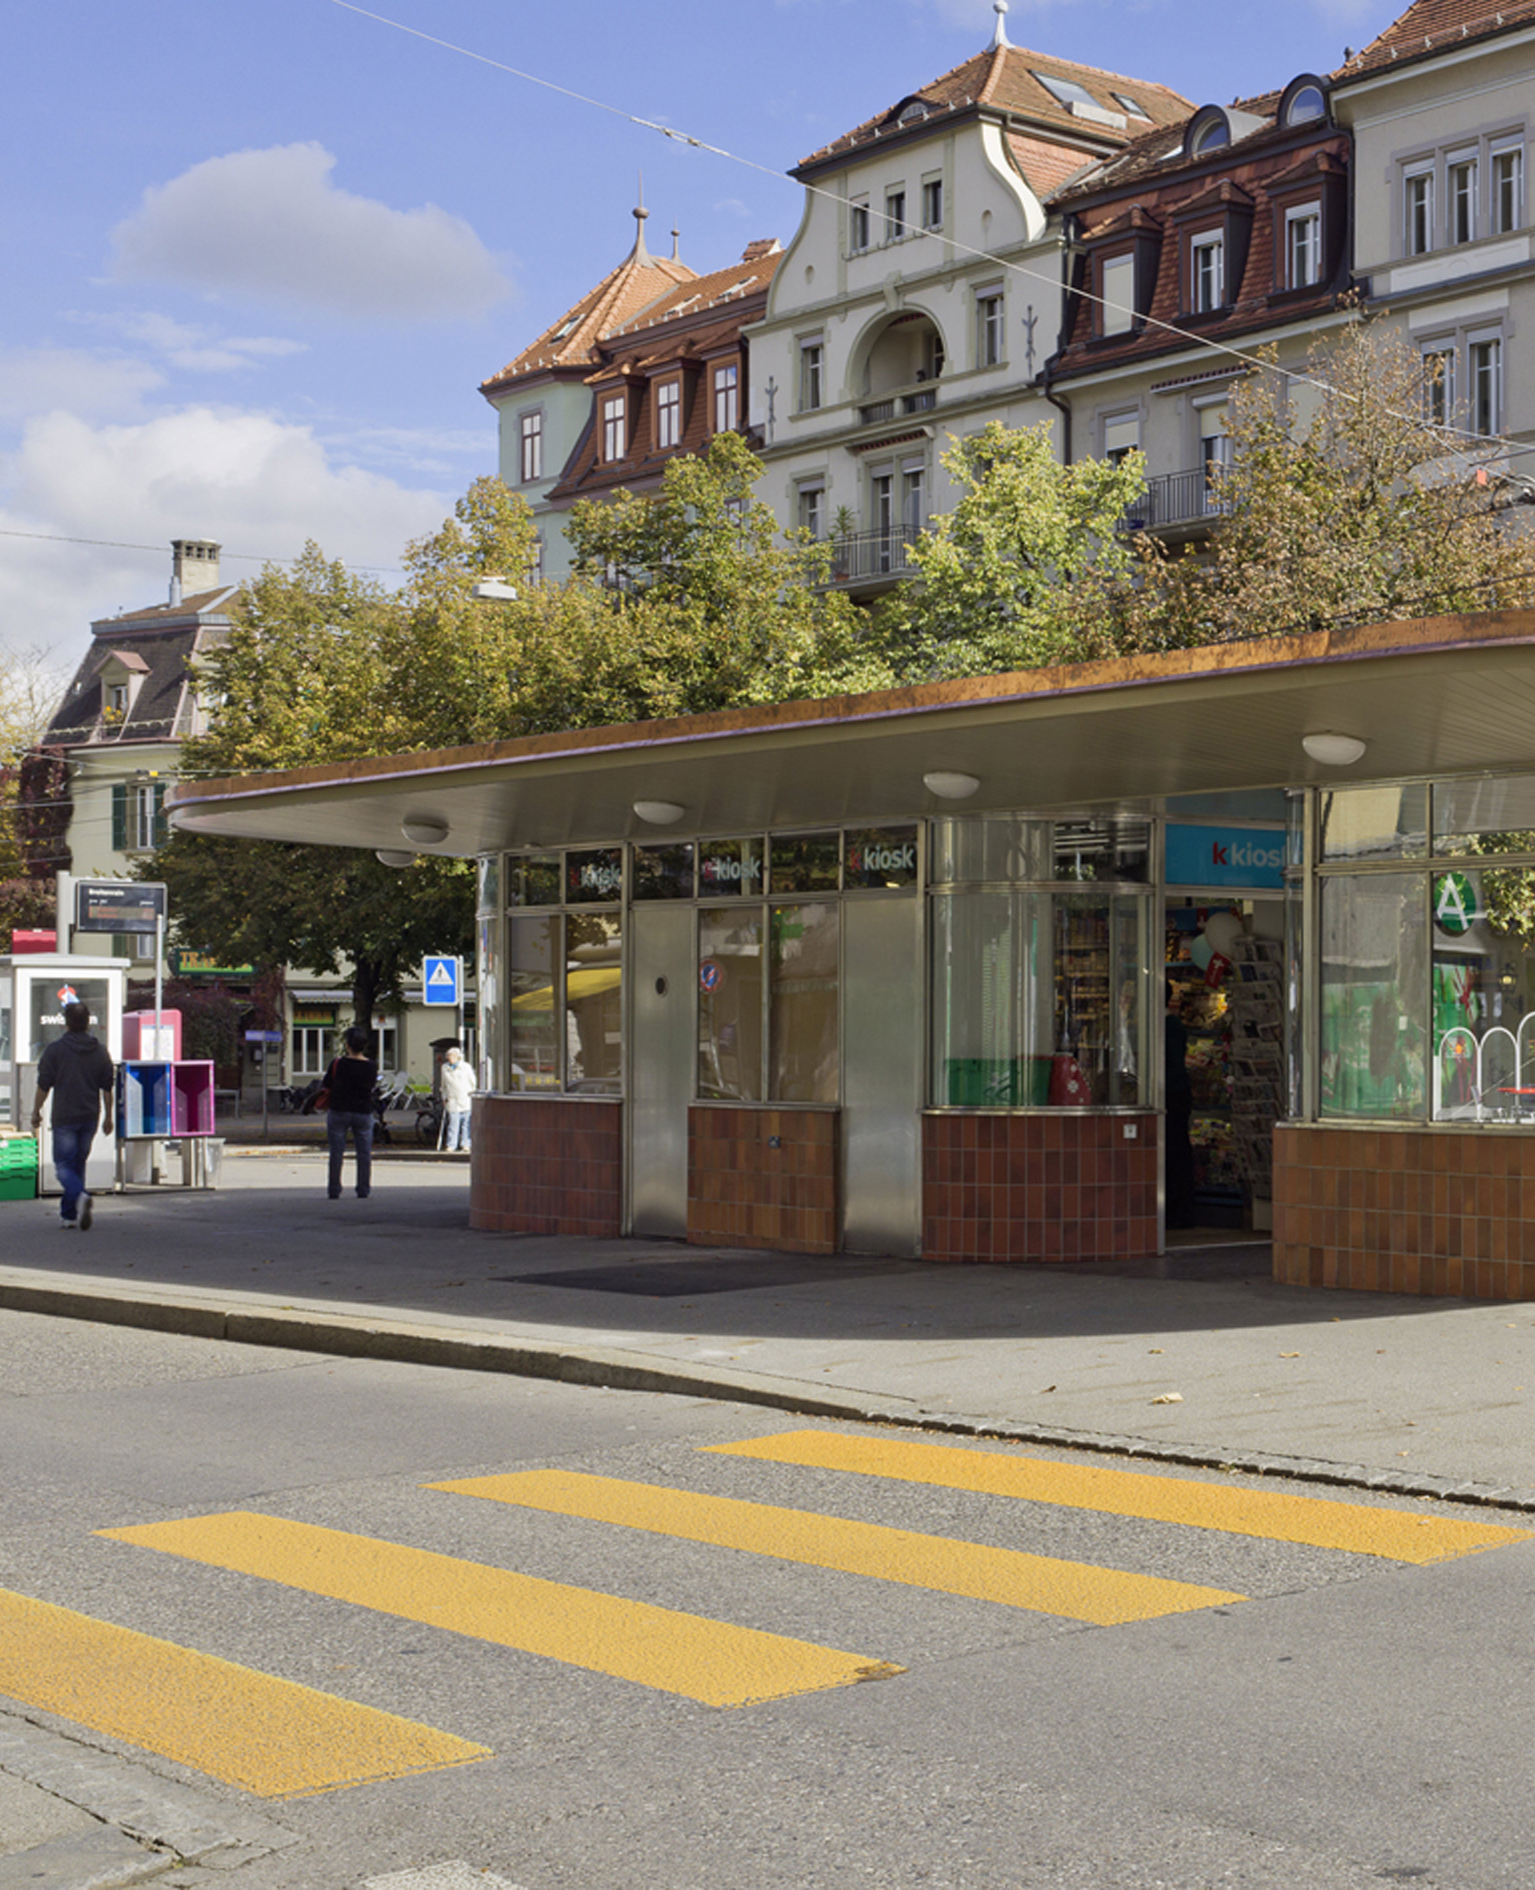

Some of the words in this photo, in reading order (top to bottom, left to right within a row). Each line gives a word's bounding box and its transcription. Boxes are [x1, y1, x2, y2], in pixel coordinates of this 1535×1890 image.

[864, 844, 914, 871] kiosk
[1212, 841, 1228, 866] k
[716, 856, 761, 881] kiosk
